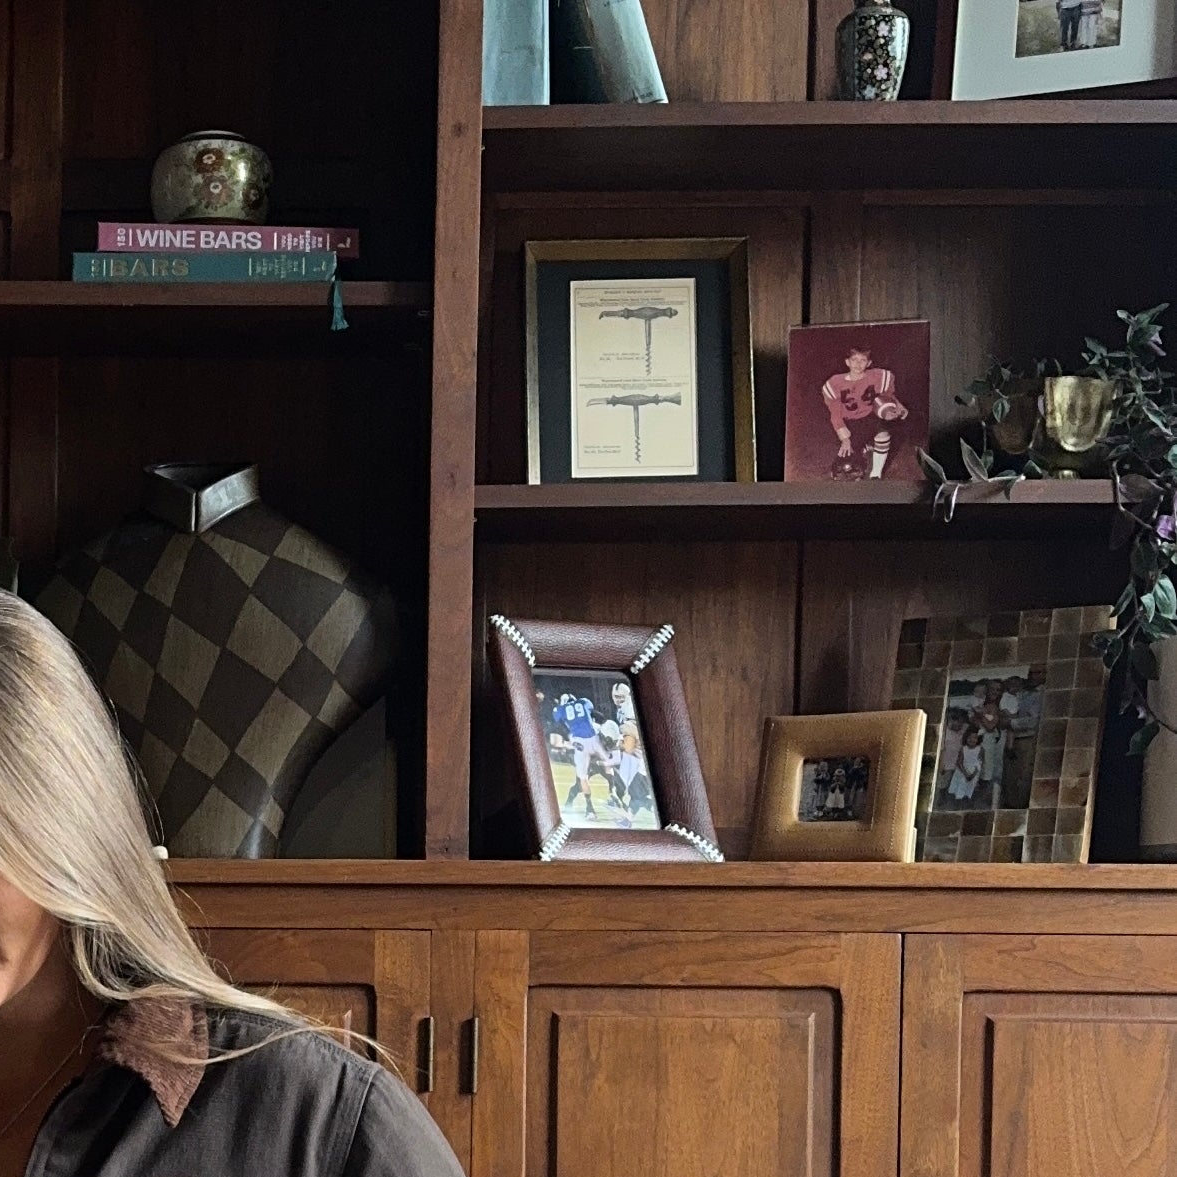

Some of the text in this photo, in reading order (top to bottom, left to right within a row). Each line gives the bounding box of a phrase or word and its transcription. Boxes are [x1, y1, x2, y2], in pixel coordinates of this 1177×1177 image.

[136, 229, 196, 249] WINE
[200, 230, 262, 250] BARS
[110, 258, 189, 277] BARS
